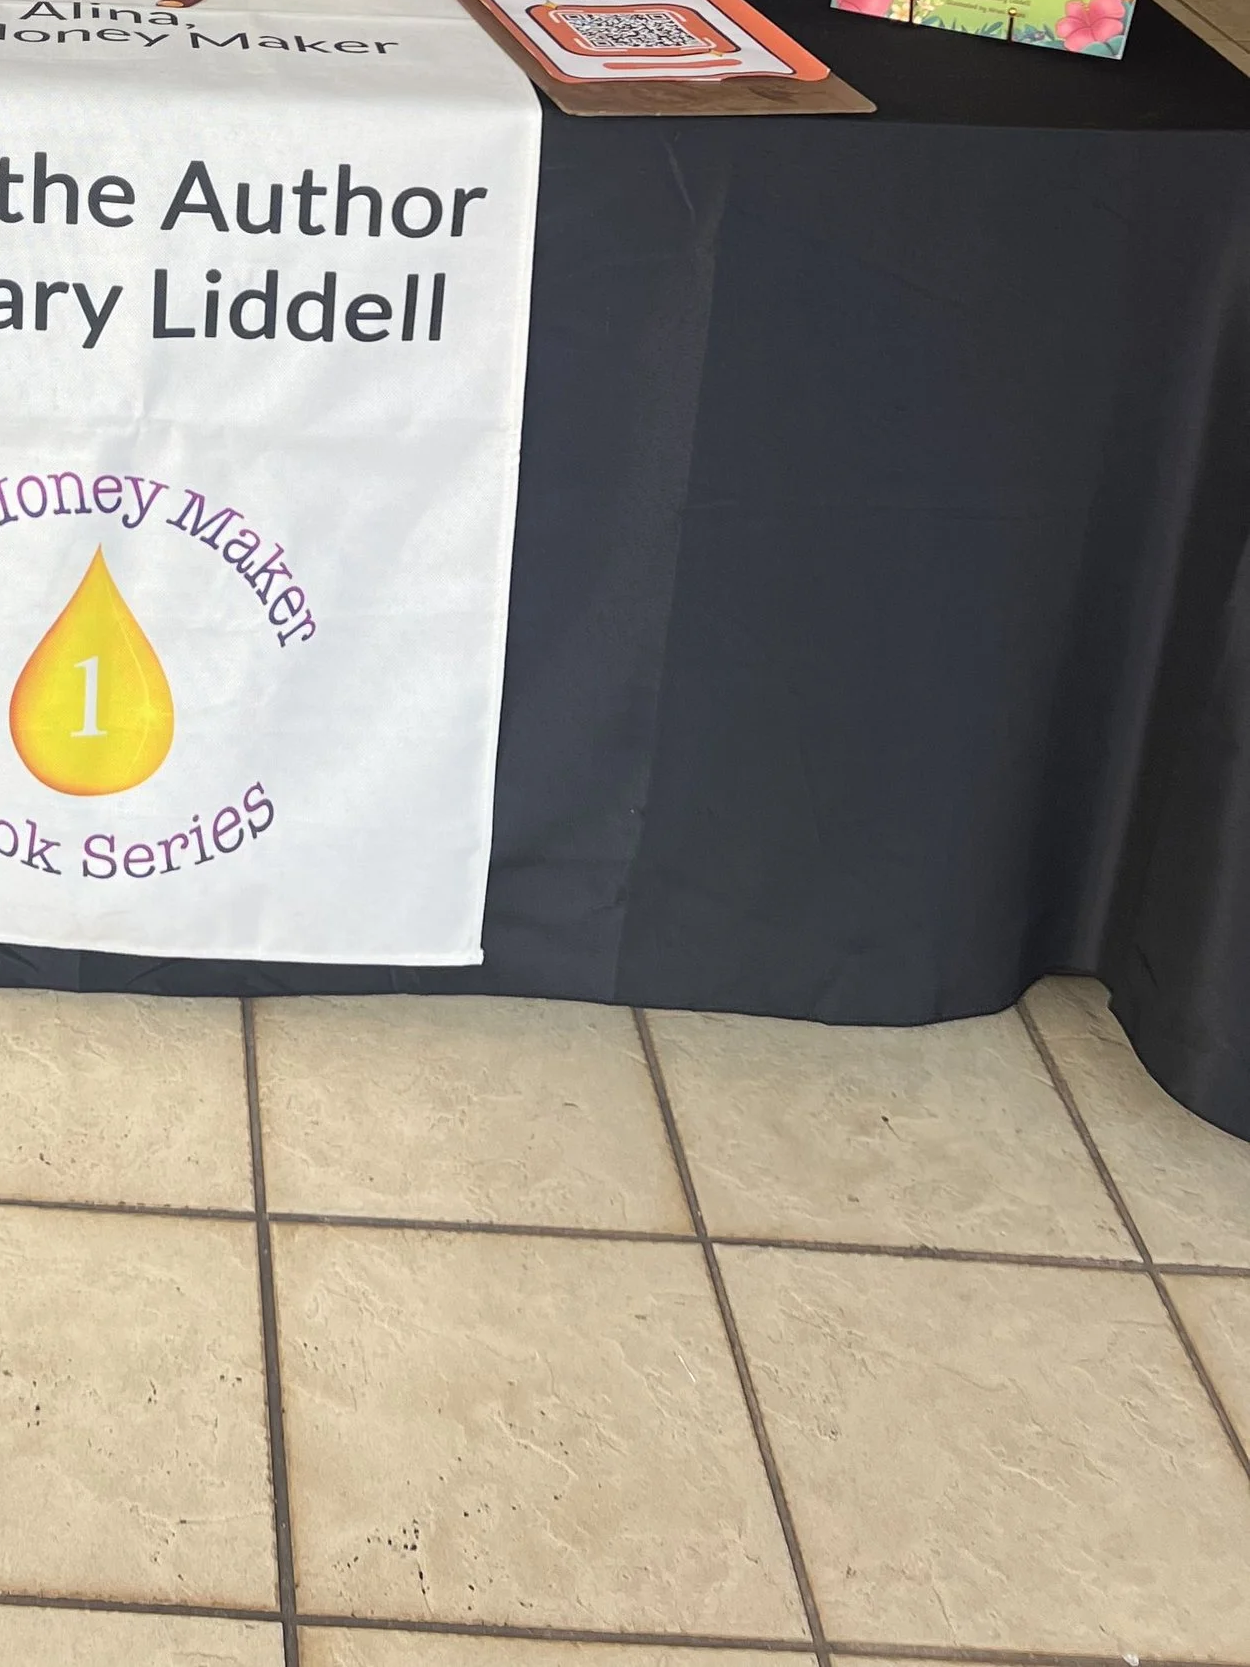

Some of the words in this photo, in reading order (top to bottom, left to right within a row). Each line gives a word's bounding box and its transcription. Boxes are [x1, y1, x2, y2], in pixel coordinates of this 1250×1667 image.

[19, 0, 196, 28] Alina,
[186, 31, 399, 56] Maker
[161, 159, 487, 239] Author
[153, 268, 446, 342] Liddell
[165, 489, 316, 648] Maker
[70, 655, 107, 738] 1
[82, 781, 275, 879] Series
